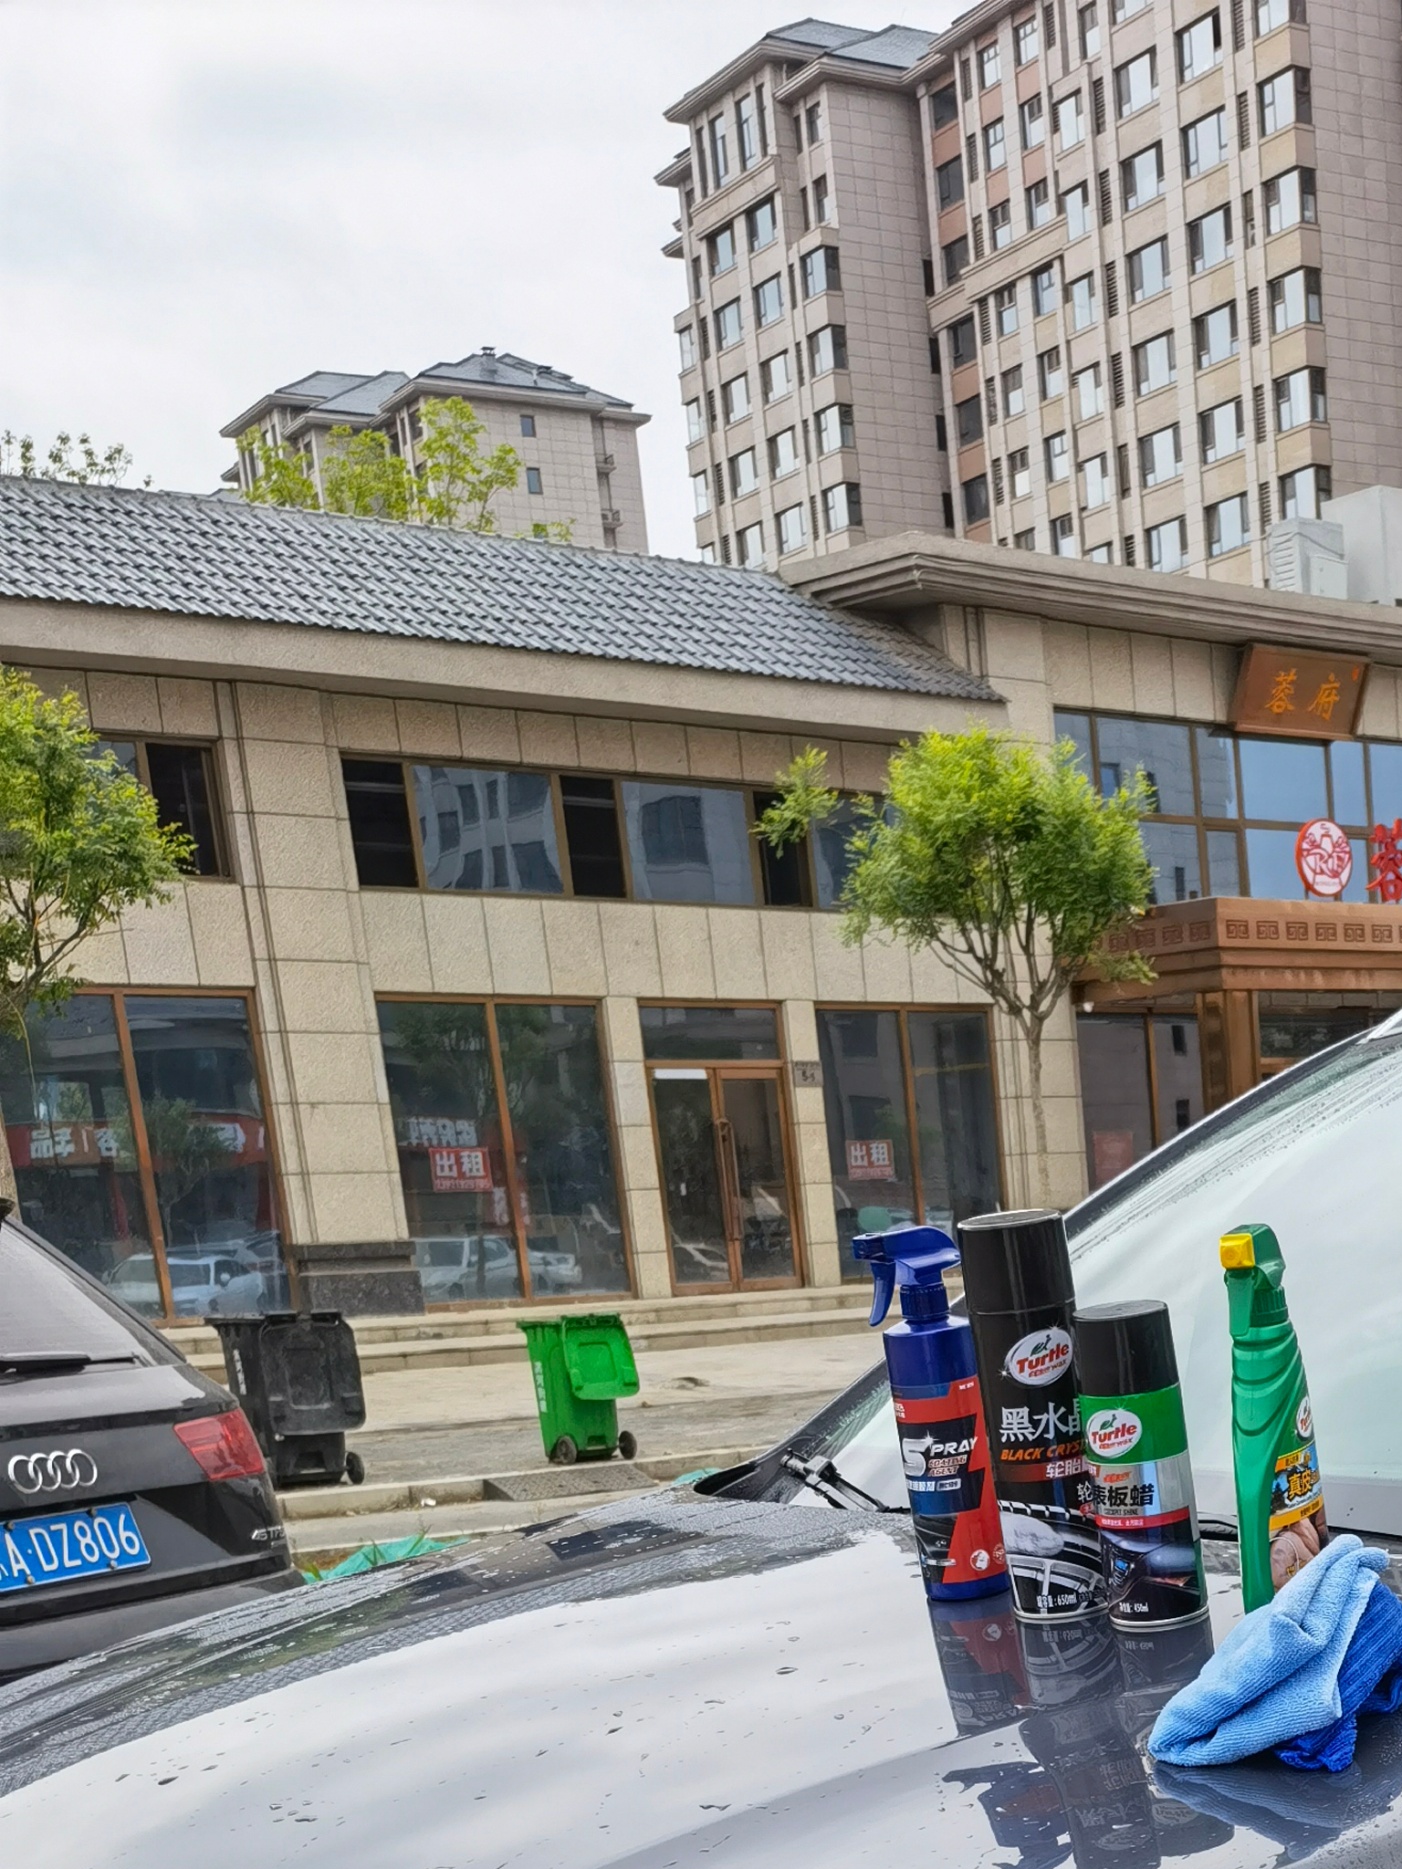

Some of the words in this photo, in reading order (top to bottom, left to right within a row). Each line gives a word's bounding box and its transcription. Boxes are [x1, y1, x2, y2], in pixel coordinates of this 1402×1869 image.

[435, 1151, 485, 1177] 出租
[851, 1142, 890, 1166] 出租
[1016, 1343, 1070, 1375] Turtle
[1091, 1423, 1137, 1444] Turtle
[1001, 1447, 1045, 1461] BLACK
